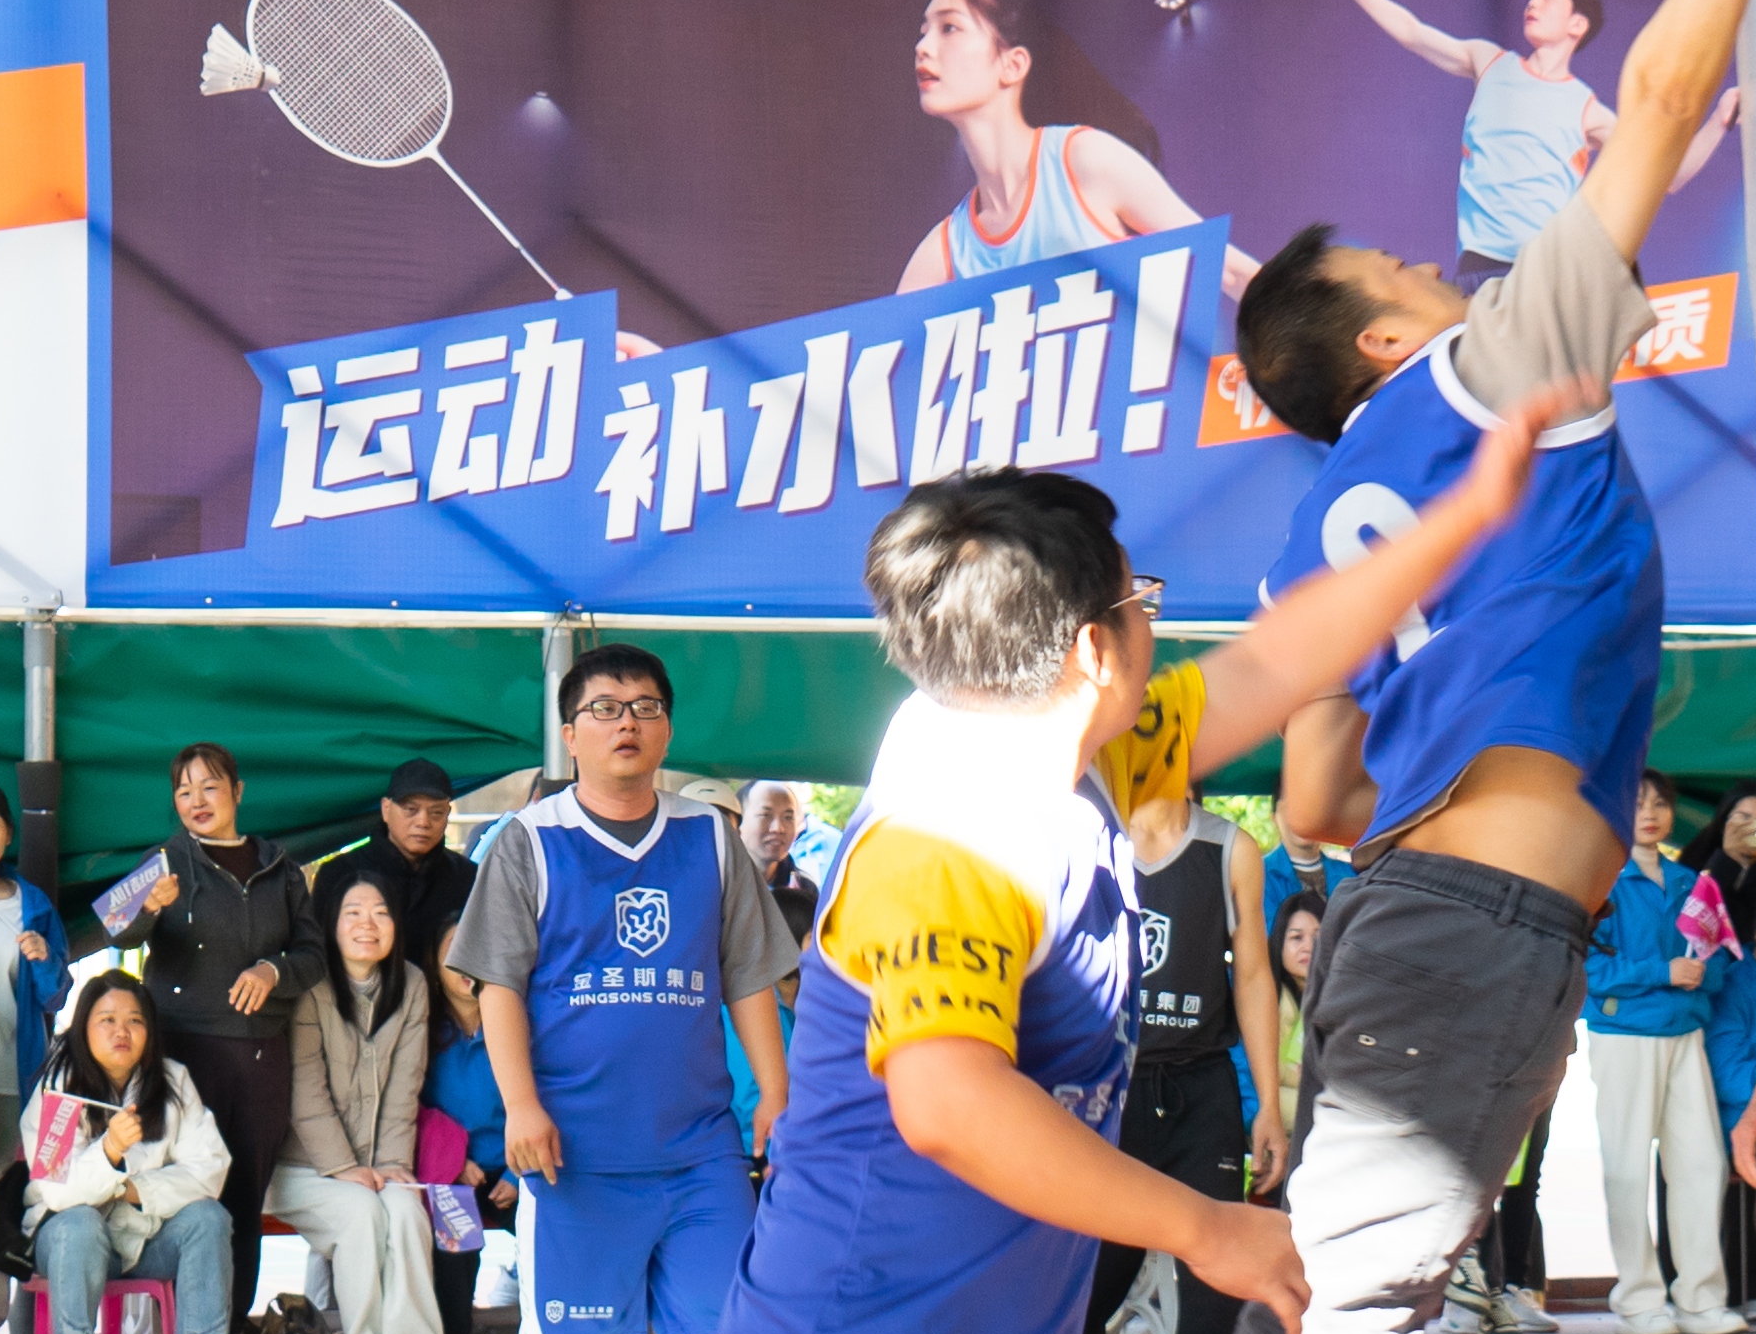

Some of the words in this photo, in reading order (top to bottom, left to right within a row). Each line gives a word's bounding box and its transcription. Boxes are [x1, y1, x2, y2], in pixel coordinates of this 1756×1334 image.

[271, 318, 585, 529] 运动
[572, 967, 705, 992] 金圣斯集团
[569, 992, 653, 1007] KINGSONS
[656, 992, 706, 1008] GROUP
[1144, 1013, 1199, 1029] GROUP
